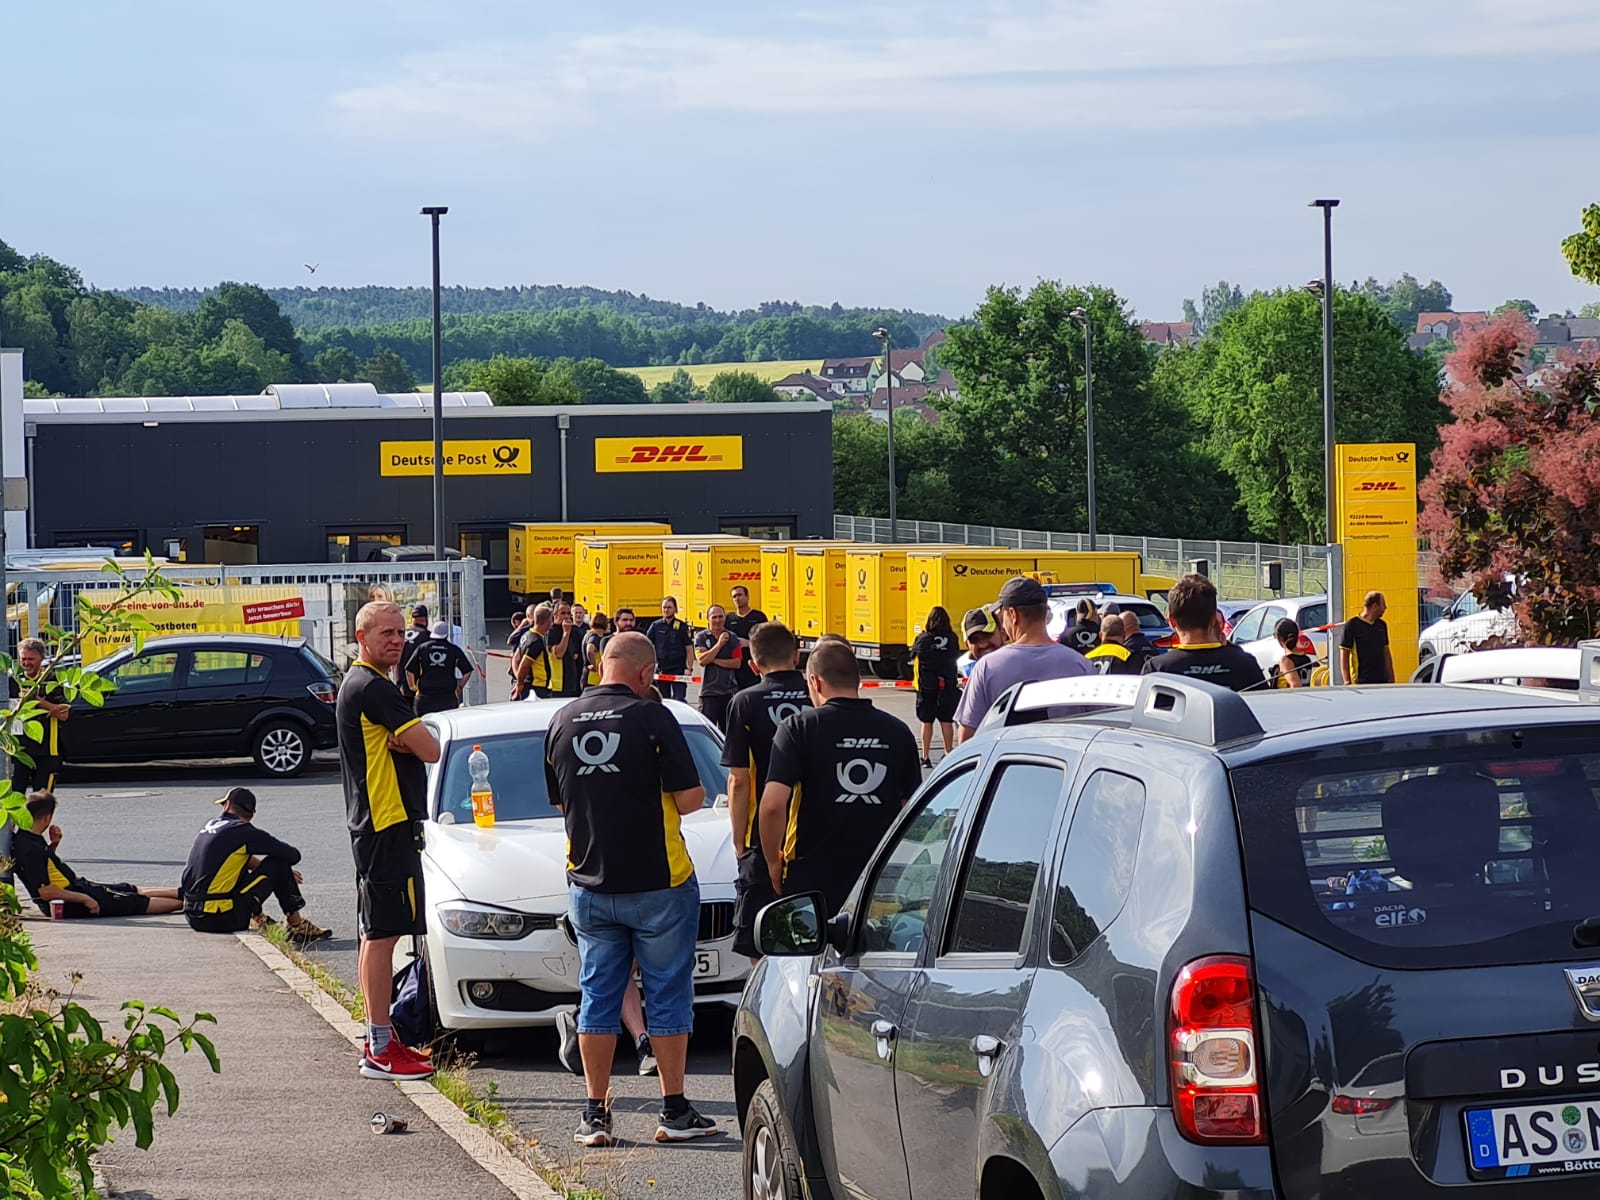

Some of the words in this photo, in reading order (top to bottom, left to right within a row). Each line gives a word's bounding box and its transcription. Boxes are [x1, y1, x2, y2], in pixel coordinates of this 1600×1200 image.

[391, 454, 454, 466] Deutse
[458, 453, 487, 465] Post
[629, 445, 709, 463] DHL
[1361, 481, 1398, 491] DHL
[539, 547, 571, 555] DHL
[624, 566, 659, 575] DHL
[970, 567, 1005, 575] Deutsche
[1006, 567, 1022, 575] Post
[1188, 665, 1224, 674] DHL
[770, 690, 806, 699] DHL
[578, 709, 616, 722] DHL
[842, 737, 883, 749] DHL
[1375, 911, 1407, 926] elf
[694, 953, 710, 973] 5
[1500, 1063, 1600, 1089] DUS
[1502, 1110, 1559, 1159] AS
[1479, 1144, 1490, 1157] D
